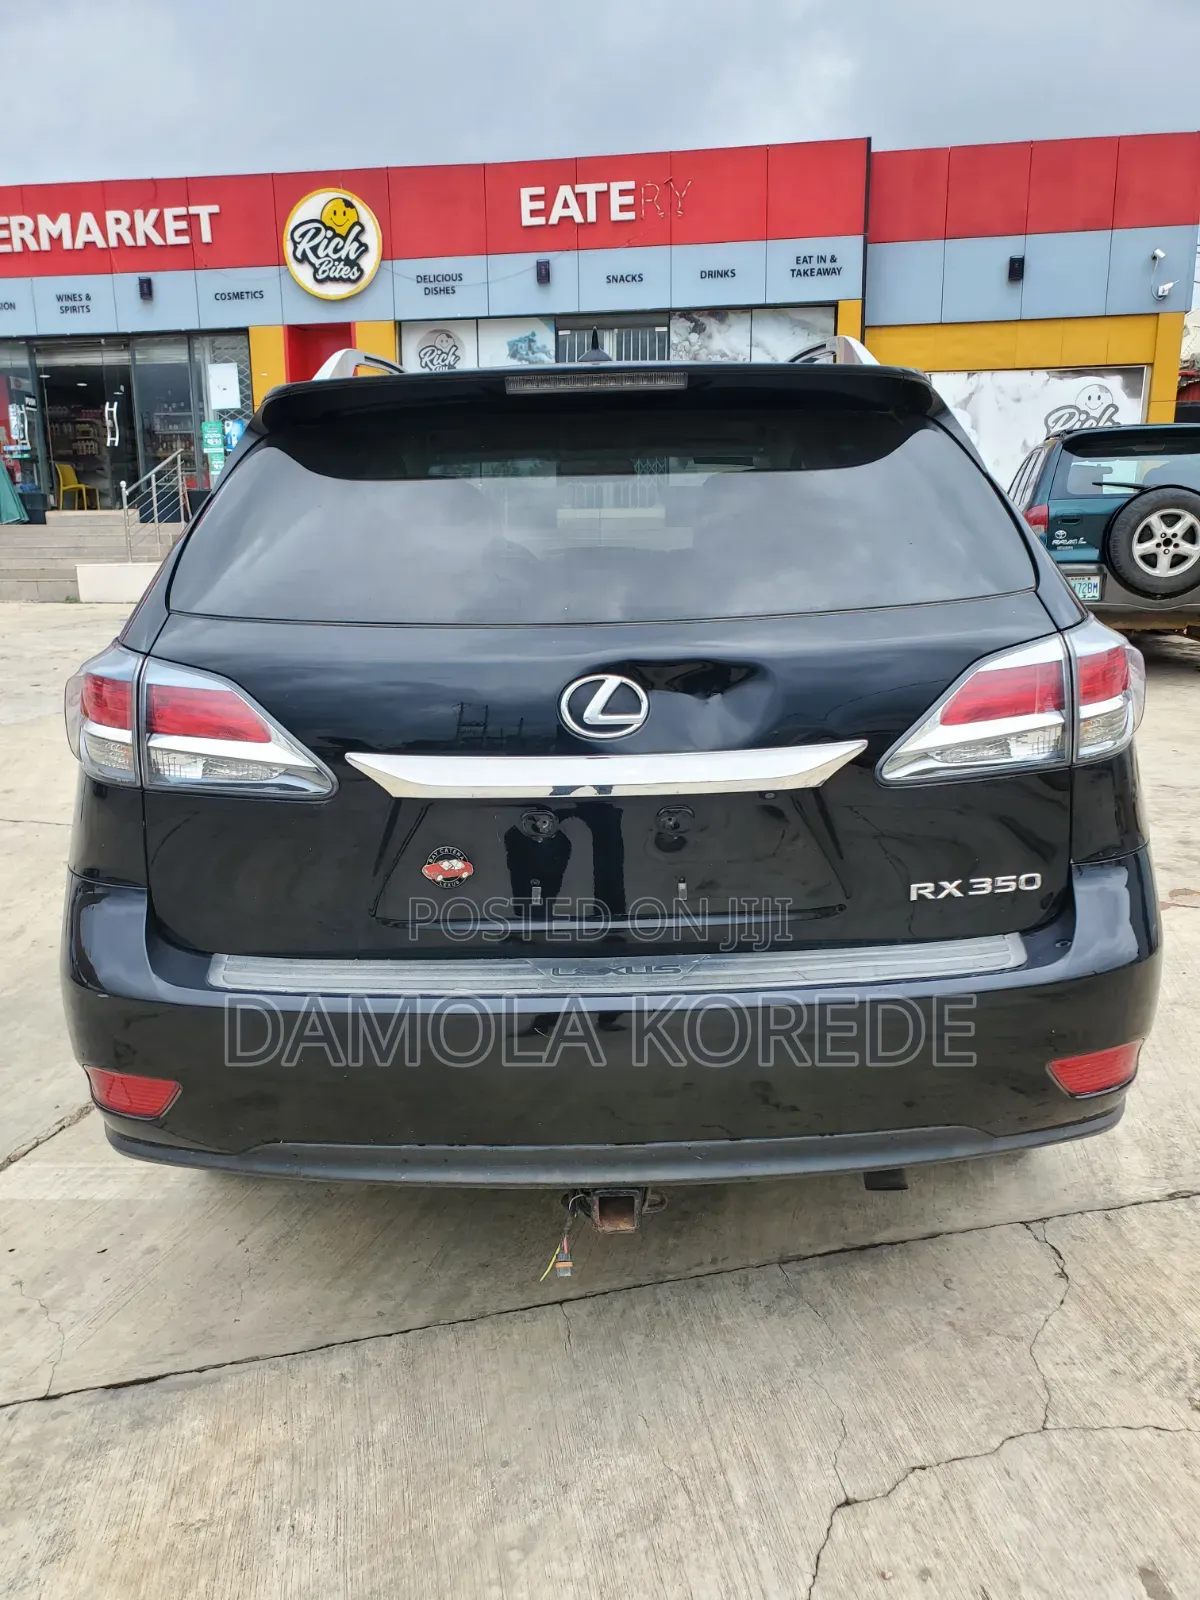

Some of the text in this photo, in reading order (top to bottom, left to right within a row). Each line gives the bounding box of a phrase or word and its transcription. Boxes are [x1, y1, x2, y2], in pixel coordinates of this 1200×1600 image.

[292, 221, 366, 263] Rich
[796, 254, 837, 265] EAT IN &
[315, 256, 361, 280] Bites
[700, 268, 736, 279] DRINKS
[790, 266, 843, 279] TAKEAWAY
[416, 273, 463, 284] DELICIOUS
[606, 273, 644, 284] SNACKS
[214, 290, 264, 301] COSMETICS
[424, 286, 456, 296] DISHES
[56, 293, 92, 303] WINES &
[0, 302, 16, 311] ION
[60, 304, 91, 315] SPIRITS
[419, 346, 459, 371] Rich
[910, 872, 1043, 901] RX 350
